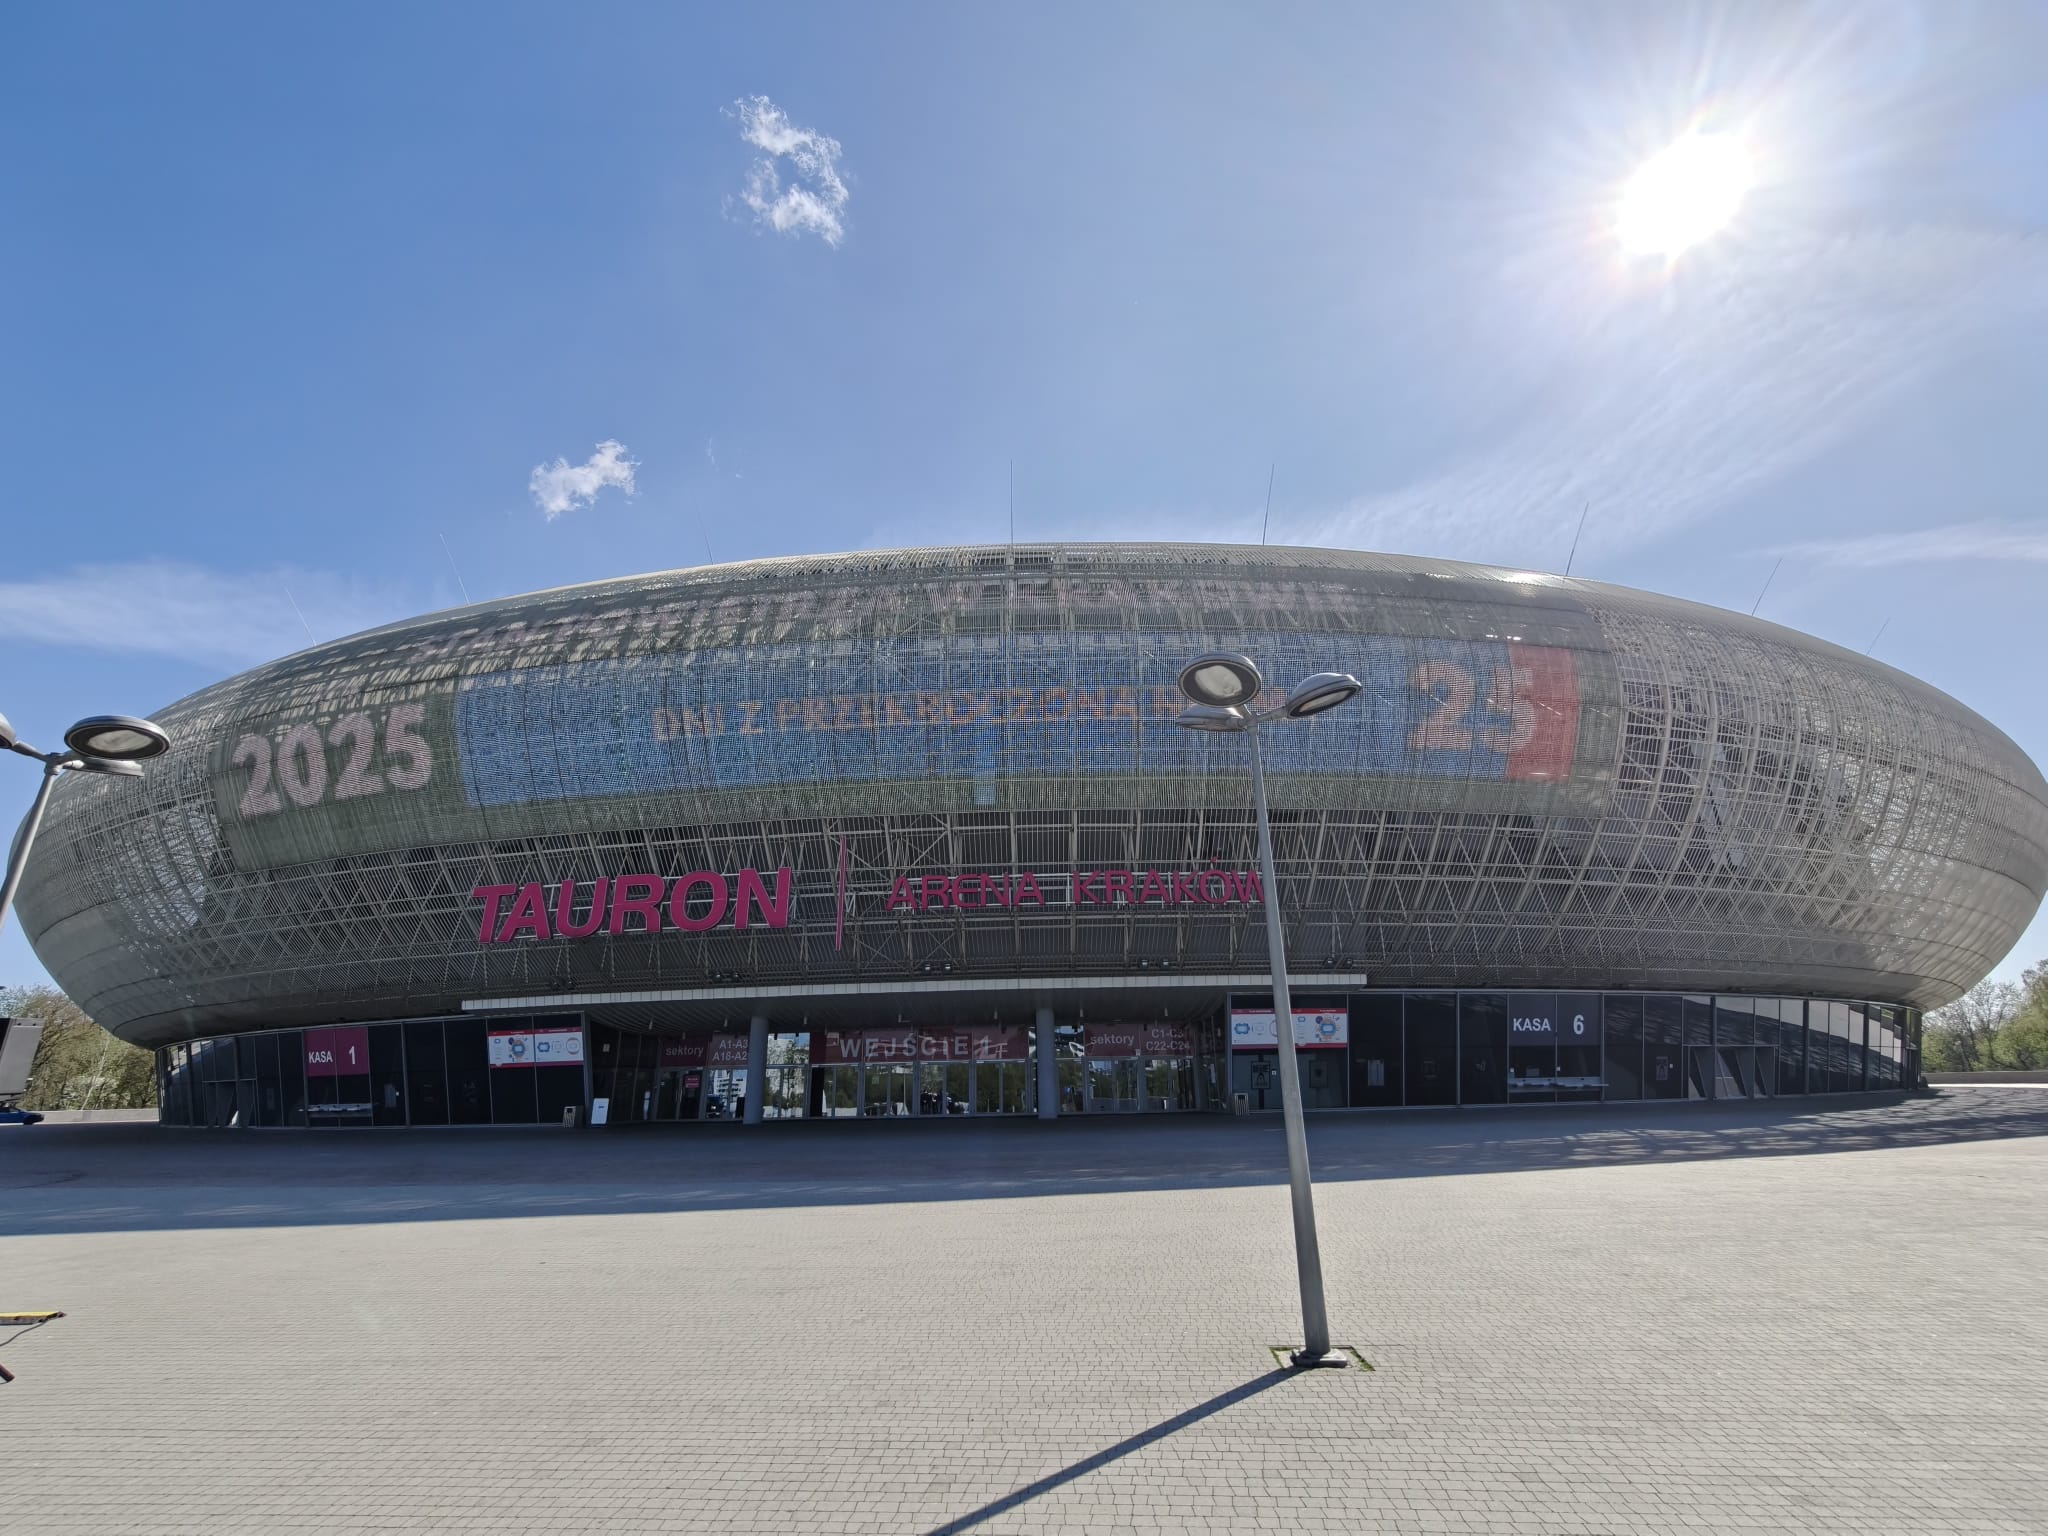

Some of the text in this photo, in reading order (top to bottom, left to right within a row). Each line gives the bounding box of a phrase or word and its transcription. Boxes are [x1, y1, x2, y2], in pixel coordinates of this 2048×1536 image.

[1407, 659, 1537, 752] 25
[652, 704, 725, 741] DNI
[737, 699, 763, 733] Z
[231, 703, 433, 818] 2025
[472, 856, 1265, 943] TAURON ARENA KRAKÓW
[1513, 1014, 1584, 1035] KASA 6
[665, 1044, 704, 1057] sektory
[840, 1032, 969, 1058] WEJŚCIE
[1090, 1033, 1134, 1046] sektory
[308, 1045, 356, 1065] KASA 1
